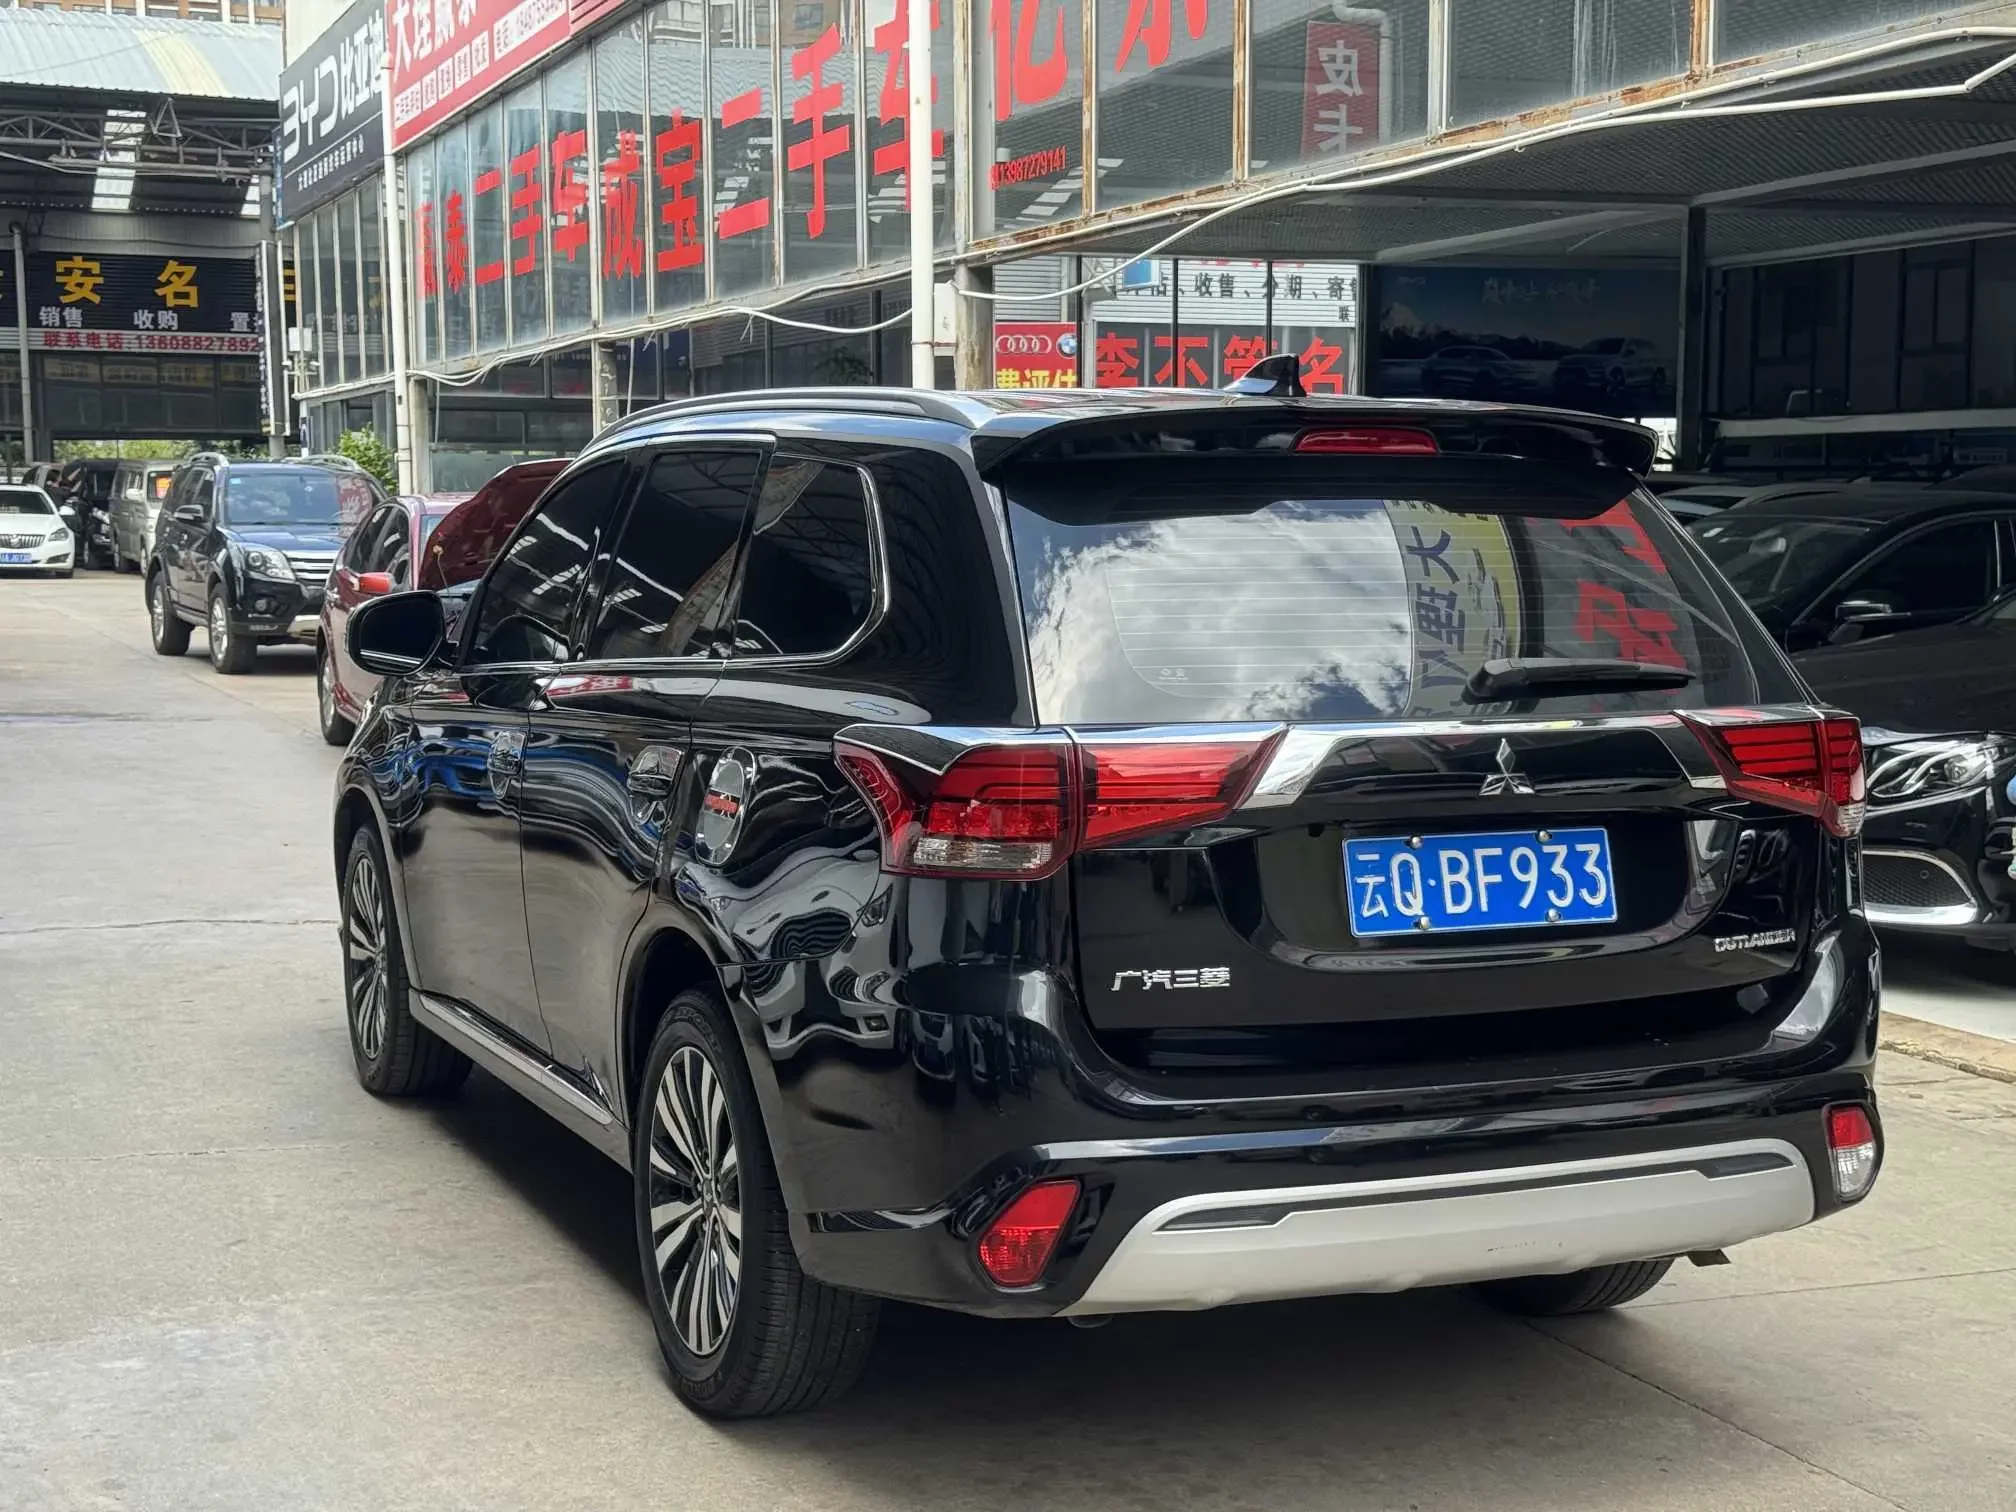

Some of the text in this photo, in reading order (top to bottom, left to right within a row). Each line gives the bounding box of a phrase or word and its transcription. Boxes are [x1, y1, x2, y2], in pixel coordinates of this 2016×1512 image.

[340, 9, 383, 120] 比亚迪
[39, 306, 83, 329] 销售
[133, 309, 179, 331] 收购
[1714, 928, 1796, 952] OUTLANDER
[1110, 966, 1230, 991] 广汽三菱
